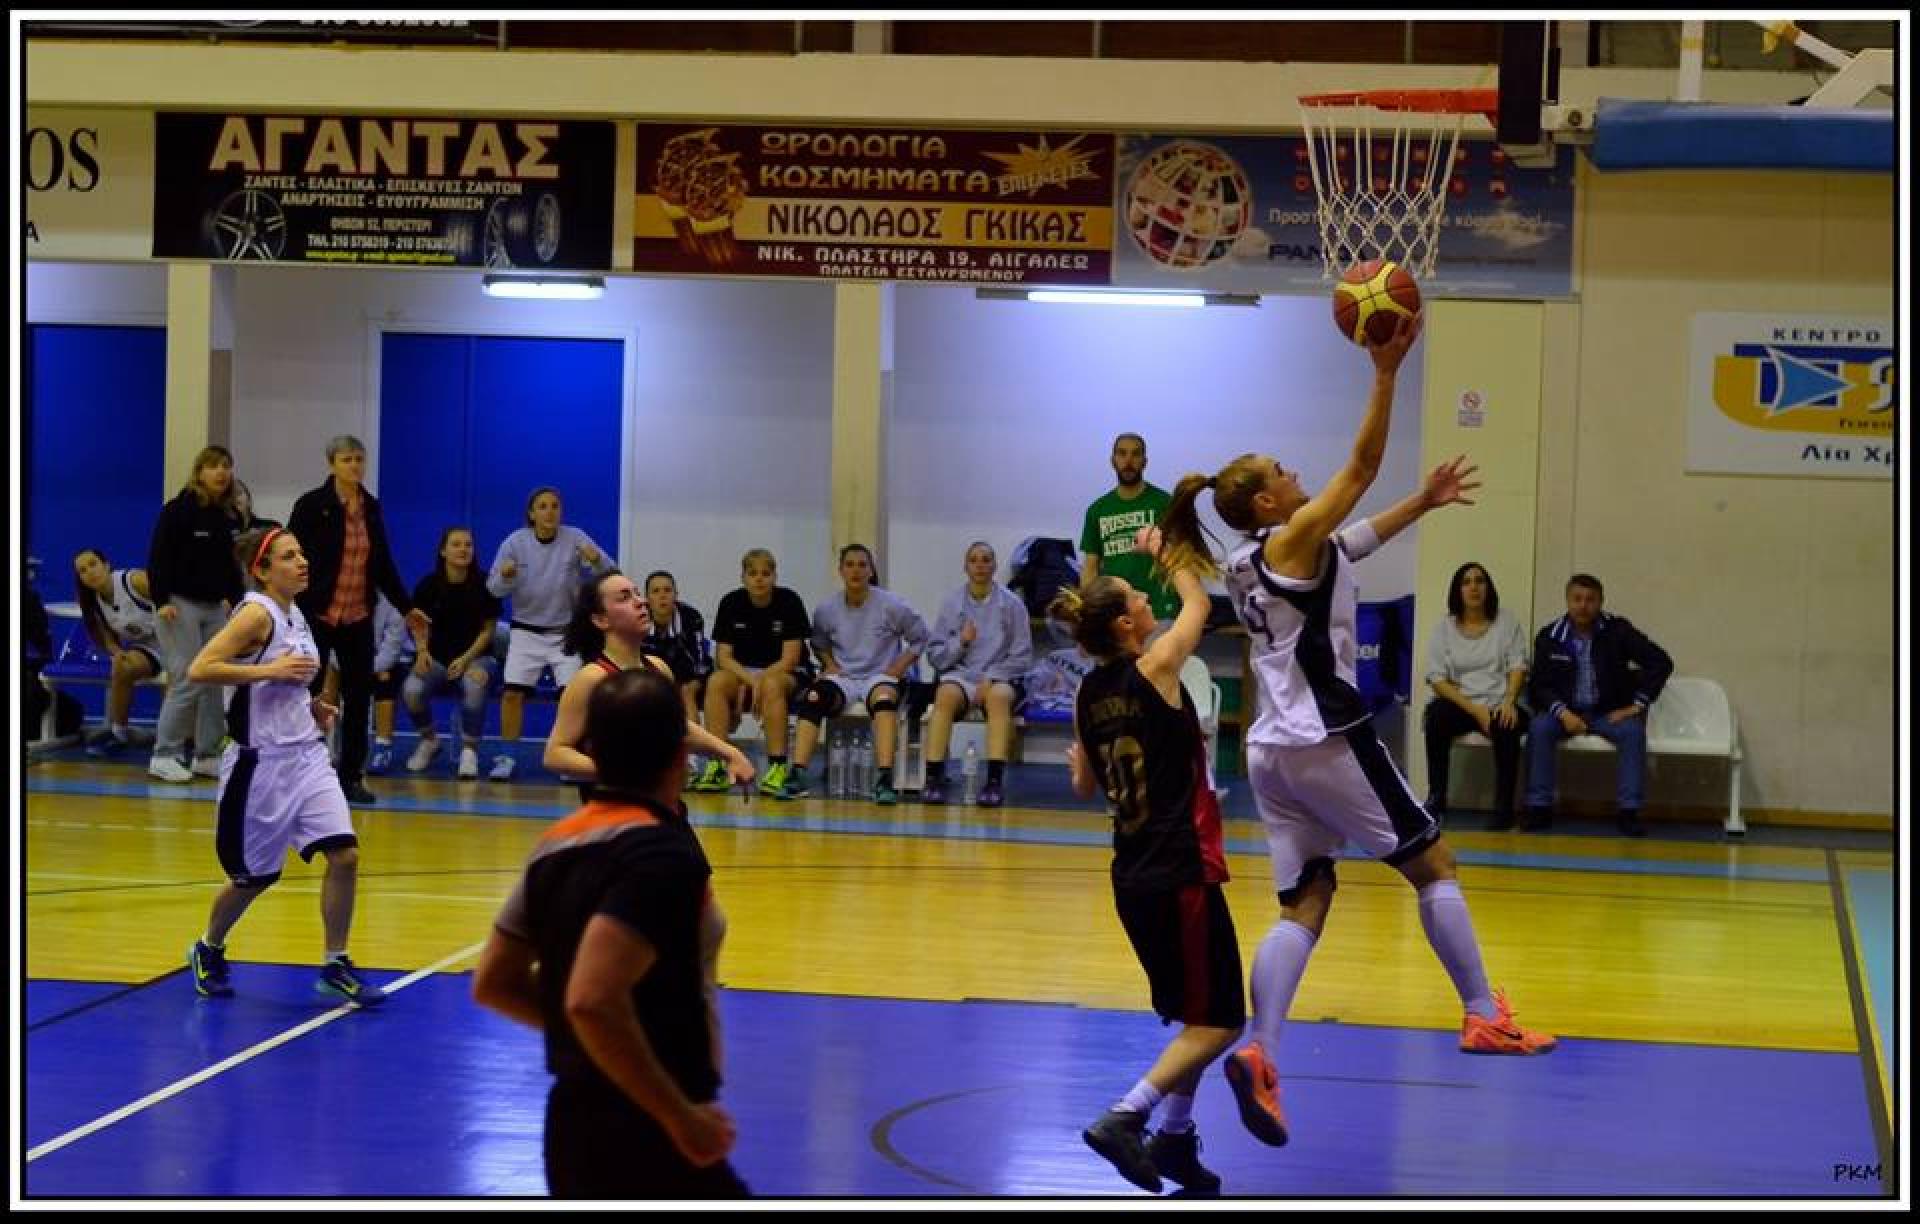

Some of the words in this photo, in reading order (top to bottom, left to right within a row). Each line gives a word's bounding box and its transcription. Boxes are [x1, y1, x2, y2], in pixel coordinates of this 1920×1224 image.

[209, 117, 559, 179] ΑΓΑΝΤΑΣ
[761, 132, 947, 159] ΩΡΟΛΟΓΙΑ
[244, 175, 297, 189] ΖΑΝΤΕΣ
[307, 177, 375, 191] ΕΛΑΣΤΙΚΑ
[386, 179, 462, 193] ΕΠΙΣΚΕΥΕΣ
[759, 165, 990, 193] ΚΟΣΜΗΜΑΤΑ
[281, 191, 365, 207] ΑΝΑΡΤΗΣΕΙΣ
[767, 203, 943, 239] ΝΙΚΟΛΑΟΣ
[965, 208, 1087, 243] ΓΚΙΚΑΣ
[757, 245, 803, 261] ΝΙΚ.
[815, 247, 935, 265] ΠΛΑΣΤΗΡΑ
[989, 253, 1089, 270] ΑΙΓΑΛΕΩ
[1773, 326, 1882, 343] ΚΕΝΤΡΟ
